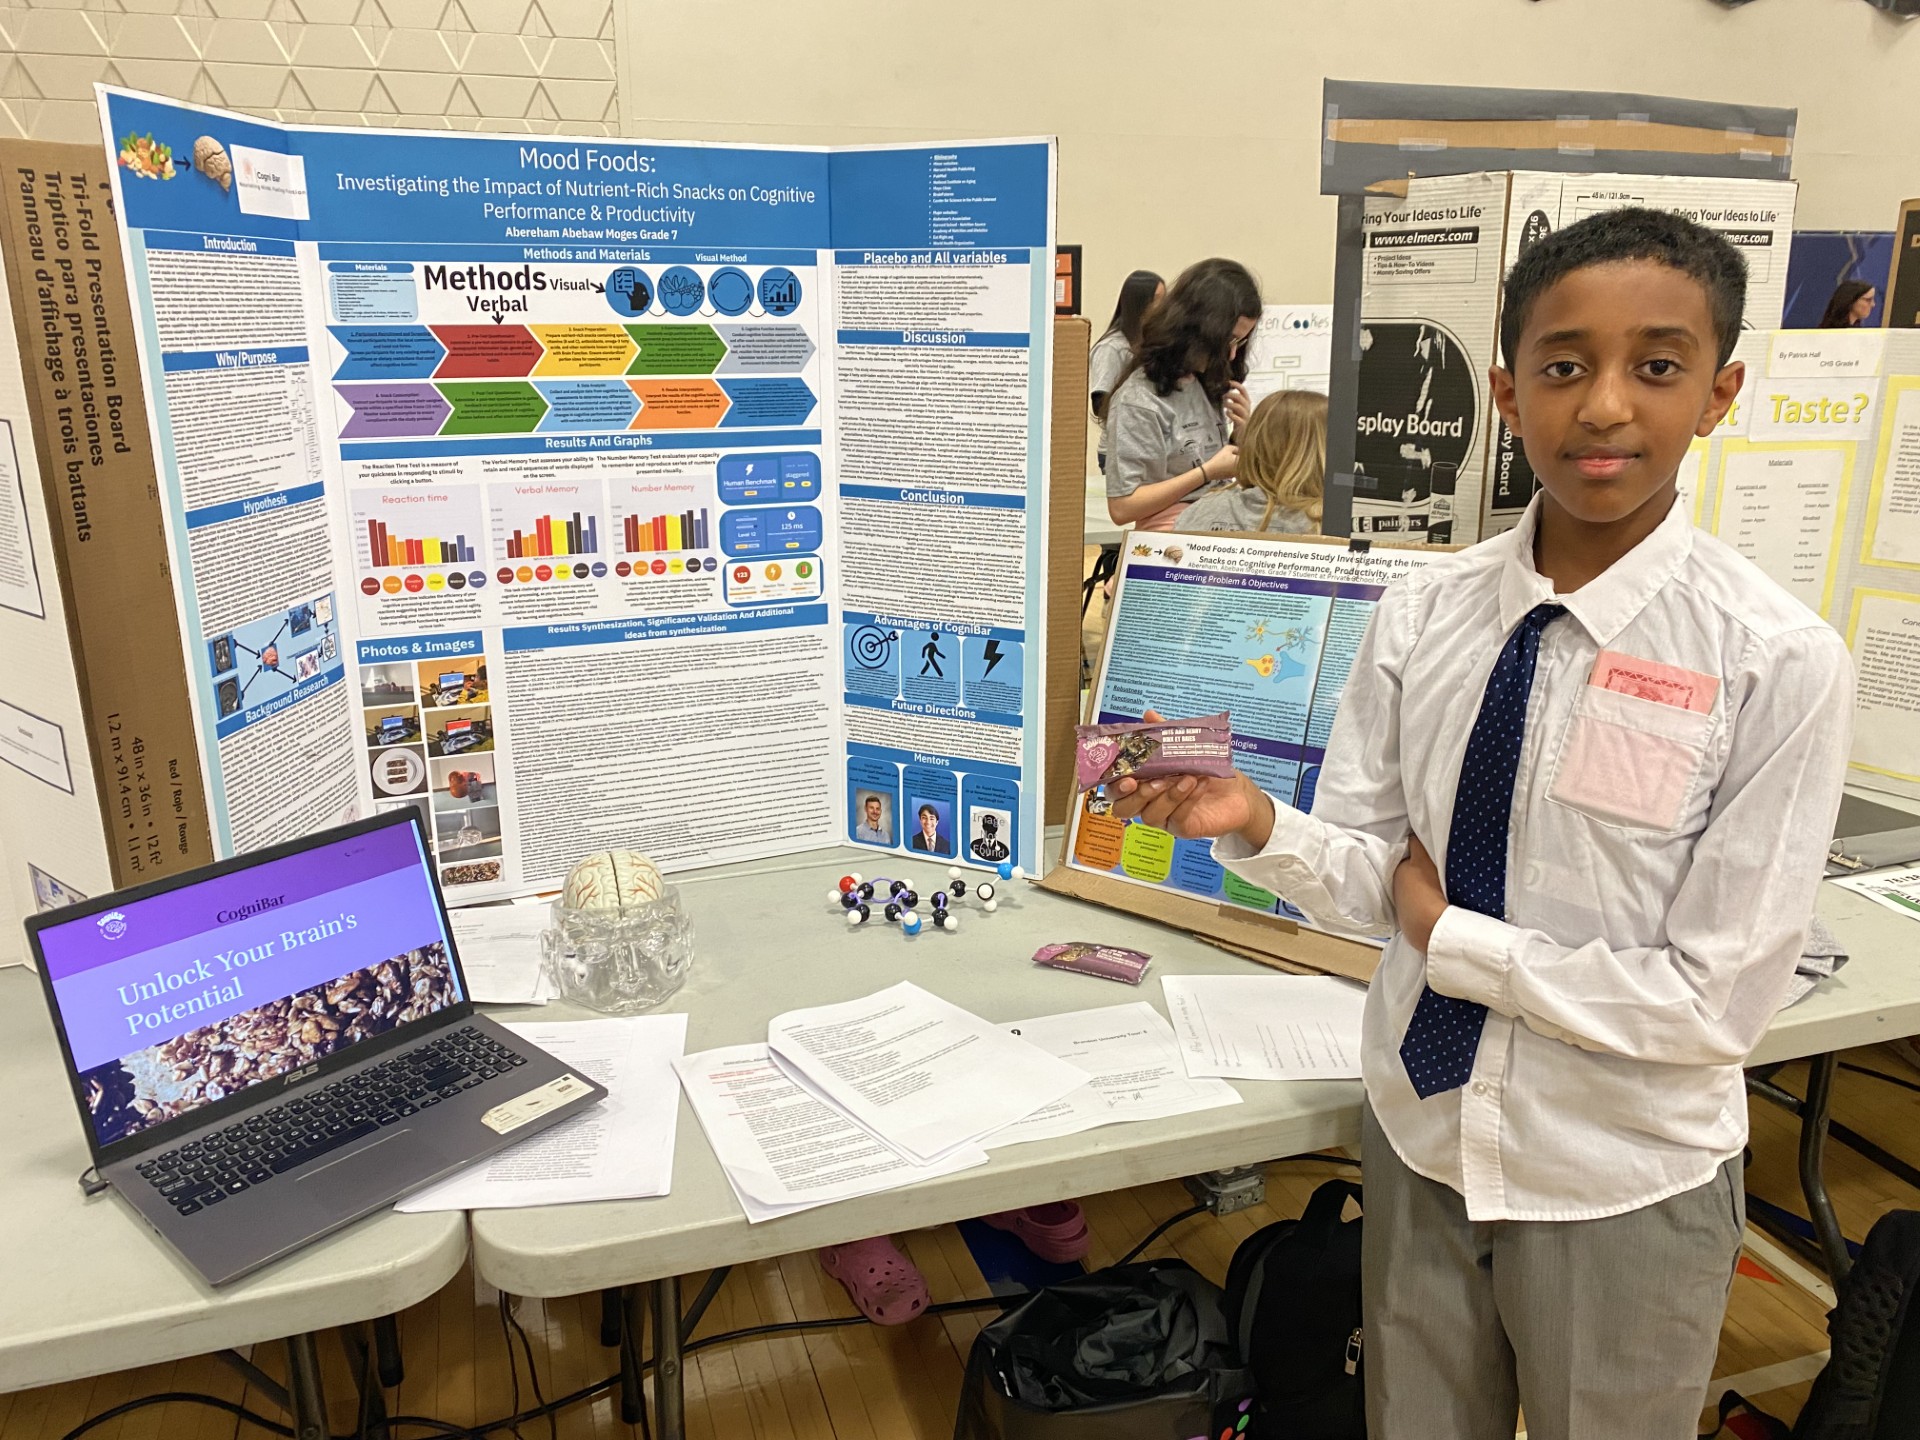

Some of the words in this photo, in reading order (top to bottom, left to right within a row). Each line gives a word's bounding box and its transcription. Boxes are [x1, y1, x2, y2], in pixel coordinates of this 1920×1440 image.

[520, 147, 579, 170] Mood
[586, 149, 656, 173] Foods:
[336, 173, 449, 196] Investigating
[452, 176, 480, 193] the
[483, 177, 542, 198] Impact
[546, 179, 562, 196] of
[566, 180, 669, 199] Nutrient-Rich
[673, 183, 725, 201] Snacks
[728, 188, 746, 201] on
[750, 186, 815, 206] Cognitive
[17, 168, 46, 261] Panneau
[44, 171, 70, 250] Tríptico
[483, 202, 586, 221] Performance
[590, 205, 602, 221] &
[606, 205, 695, 226] Productivity
[1361, 213, 1382, 226] ring
[1384, 211, 1410, 223] Your
[1412, 209, 1444, 221] Ideas
[1446, 208, 1457, 219] to
[505, 227, 560, 238] Abereham
[562, 229, 604, 240] Abebaw
[606, 230, 637, 241] Moges
[640, 230, 669, 240] Grade
[671, 230, 678, 240] 7
[1374, 231, 1473, 245] www.elmers.com
[1722, 231, 1769, 244] lmers.com
[203, 236, 257, 252] Introduction
[523, 248, 573, 260] Methods
[575, 248, 596, 260] and
[601, 249, 650, 261] Materials
[695, 253, 719, 262] Visual
[720, 254, 747, 263] Method
[864, 252, 908, 264] Placebo
[911, 252, 931, 264] and
[934, 251, 950, 264] All
[953, 251, 1007, 264] variables
[355, 263, 388, 272] Materials
[54, 259, 78, 305] para
[424, 264, 547, 291] Methods
[549, 278, 591, 291] Visual
[466, 295, 528, 312] Verbal
[70, 173, 100, 251] Tri-Fold
[85, 259, 117, 388] Presentation
[107, 395, 131, 454] Board
[35, 268, 65, 382] d'affichage
[1257, 317, 1279, 330] een
[903, 331, 966, 344] Discussion
[215, 352, 277, 367] Why/Purpose
[1779, 351, 1787, 360] By
[55, 389, 71, 400] à
[64, 312, 104, 467] presentaciones
[1770, 393, 1869, 424] Taste?
[58, 407, 79, 454] trois
[1357, 412, 1404, 437] splay
[1407, 413, 1463, 437] Board
[545, 438, 587, 449] Results
[589, 436, 611, 447] And
[613, 436, 653, 449] Graphs
[1768, 459, 1793, 467] Materials
[723, 479, 744, 487] Human
[745, 478, 776, 486] Benchmark
[1499, 451, 1513, 496] Board
[515, 485, 544, 494] Verbal
[546, 485, 579, 495] Memory
[631, 484, 662, 492] Number
[663, 483, 695, 493] Memory
[900, 490, 965, 504] Conclusion
[66, 461, 92, 543] battants
[243, 494, 288, 514] Hypothesis
[382, 495, 425, 504] Reaction
[427, 493, 448, 502] time
[1378, 518, 1422, 531] painrs
[1186, 543, 1211, 552] "Mood
[1212, 544, 1237, 554] Foods:
[1246, 548, 1309, 560] Comprehensive
[1310, 552, 1335, 563] Study
[1394, 559, 1409, 567] the
[1199, 556, 1225, 565] Snacks
[1239, 559, 1276, 570] Cognitive
[1277, 562, 1332, 574] Performance,
[1334, 566, 1390, 579] Productivity,
[1165, 571, 1206, 584] Engineering
[1208, 575, 1240, 586] Problem
[1241, 578, 1247, 586] &
[1248, 578, 1289, 590] Objectives
[548, 625, 580, 635] Results
[582, 620, 645, 632] Synthesization,
[647, 615, 697, 628] Significance
[698, 612, 737, 622] Validation
[739, 610, 754, 619] And
[756, 607, 794, 617] Additional
[874, 615, 930, 631] Advantages
[933, 621, 943, 631] of
[945, 622, 991, 636] CogniBar
[624, 630, 646, 640] ideas
[648, 628, 667, 637] from
[669, 625, 727, 637] synthesization
[361, 643, 408, 658] Photos
[411, 642, 423, 654] &
[425, 639, 475, 653] Images
[1113, 685, 1143, 695] Robustness
[245, 690, 292, 724] Background
[293, 675, 329, 705] Reasearch
[1111, 695, 1145, 705] Functionality
[891, 700, 923, 712] Future
[925, 703, 976, 719] Directions
[1109, 704, 1143, 714] Specification
[1230, 739, 1258, 750] ologies
[914, 753, 950, 766] Mentors
[168, 759, 180, 779] Red
[172, 788, 183, 812] Rojo
[972, 812, 1005, 828] Image
[178, 823, 188, 854] Rouge
[973, 843, 1005, 858] Found
[216, 894, 285, 924] CogniBar
[116, 960, 214, 1007] Unlock
[214, 939, 275, 973] Your
[279, 912, 358, 952] Brain's
[125, 975, 245, 1037] Potential
[283, 1063, 319, 1086] ASUS
